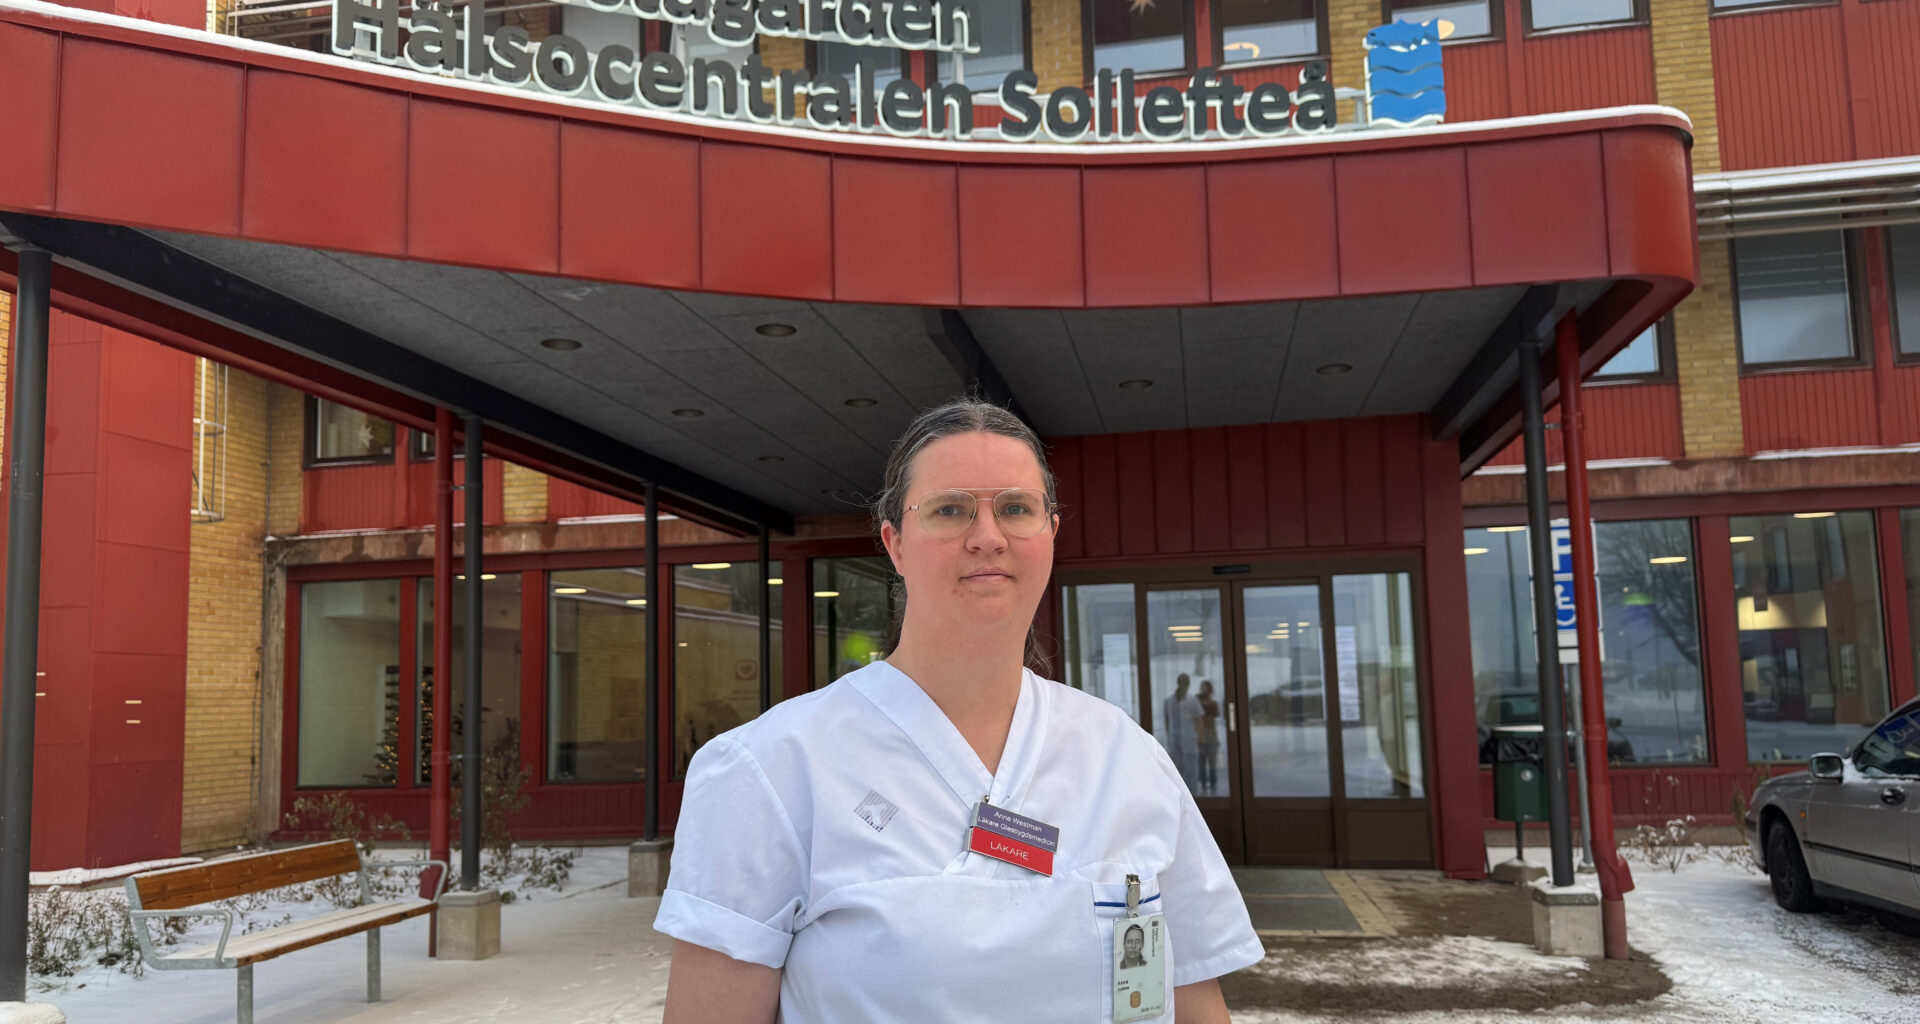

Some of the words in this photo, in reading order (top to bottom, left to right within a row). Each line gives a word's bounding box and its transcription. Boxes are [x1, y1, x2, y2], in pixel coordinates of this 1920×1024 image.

[332, 0, 972, 139] Hälsocentralen
[999, 60, 1337, 143] Sollefteå
[994, 811, 1011, 822] Anna
[1012, 817, 1043, 832] Westman
